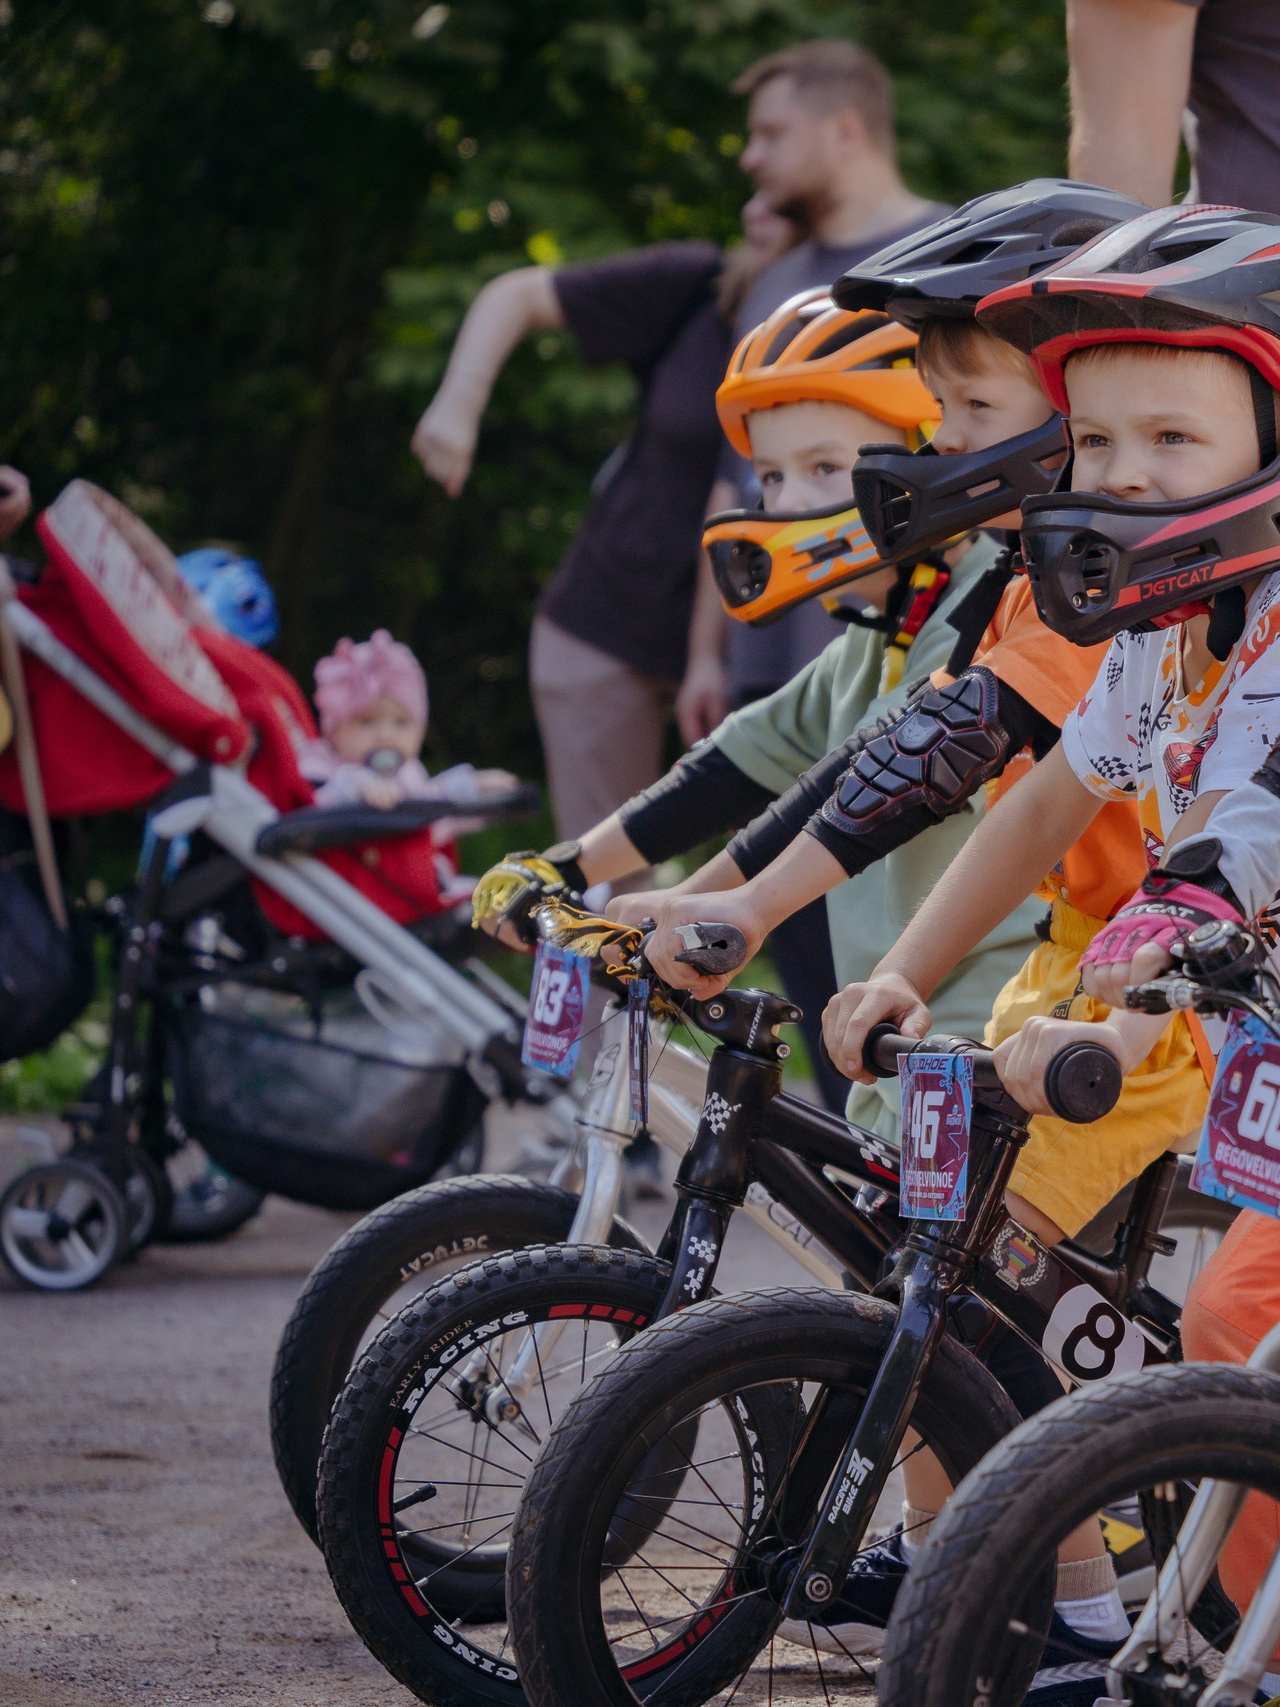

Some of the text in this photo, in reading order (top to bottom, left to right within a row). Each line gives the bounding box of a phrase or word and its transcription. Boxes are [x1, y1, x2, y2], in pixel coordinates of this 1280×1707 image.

[1142, 565, 1211, 600] JETCAT
[533, 968, 570, 1027] 83
[910, 1090, 946, 1160] 46
[389, 1318, 475, 1408] EARLY RIDER
[402, 1310, 529, 1414] RACING
[1060, 1302, 1126, 1381] 8
[827, 1476, 852, 1525] RACING
[841, 1483, 859, 1516] BIKE
[432, 1623, 519, 1681] CING
